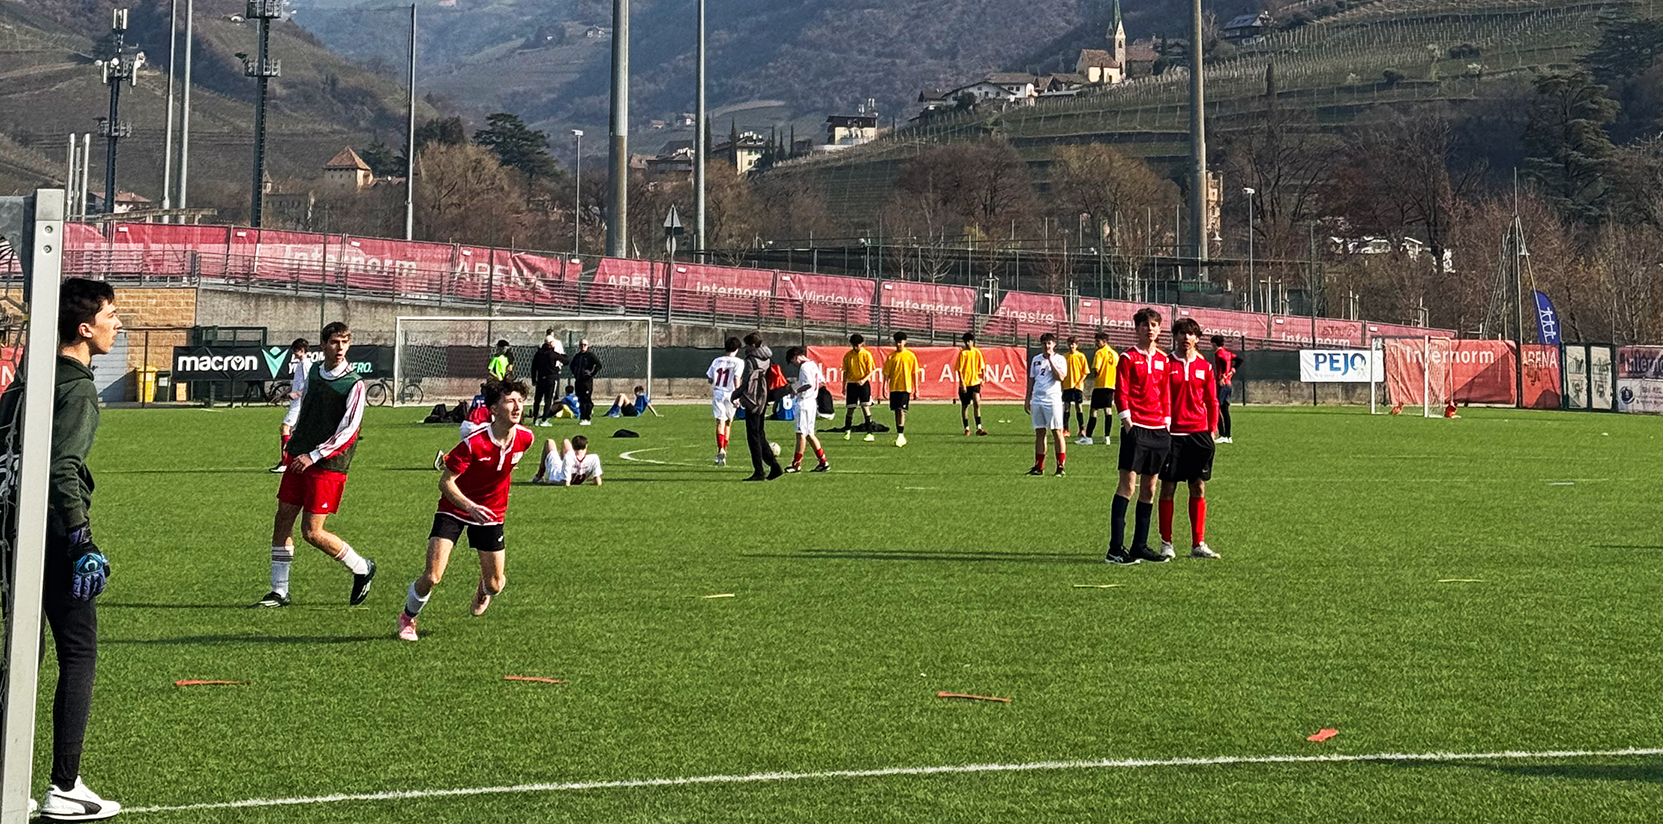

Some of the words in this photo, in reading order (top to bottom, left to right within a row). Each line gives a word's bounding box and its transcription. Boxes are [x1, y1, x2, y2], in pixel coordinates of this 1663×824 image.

[798, 289, 864, 308] Windows
[999, 306, 1054, 324] Finestre
[177, 355, 258, 371] macron
[1313, 353, 1366, 376] PEJO
[1522, 350, 1558, 369] ARENA
[714, 367, 729, 387] 11
